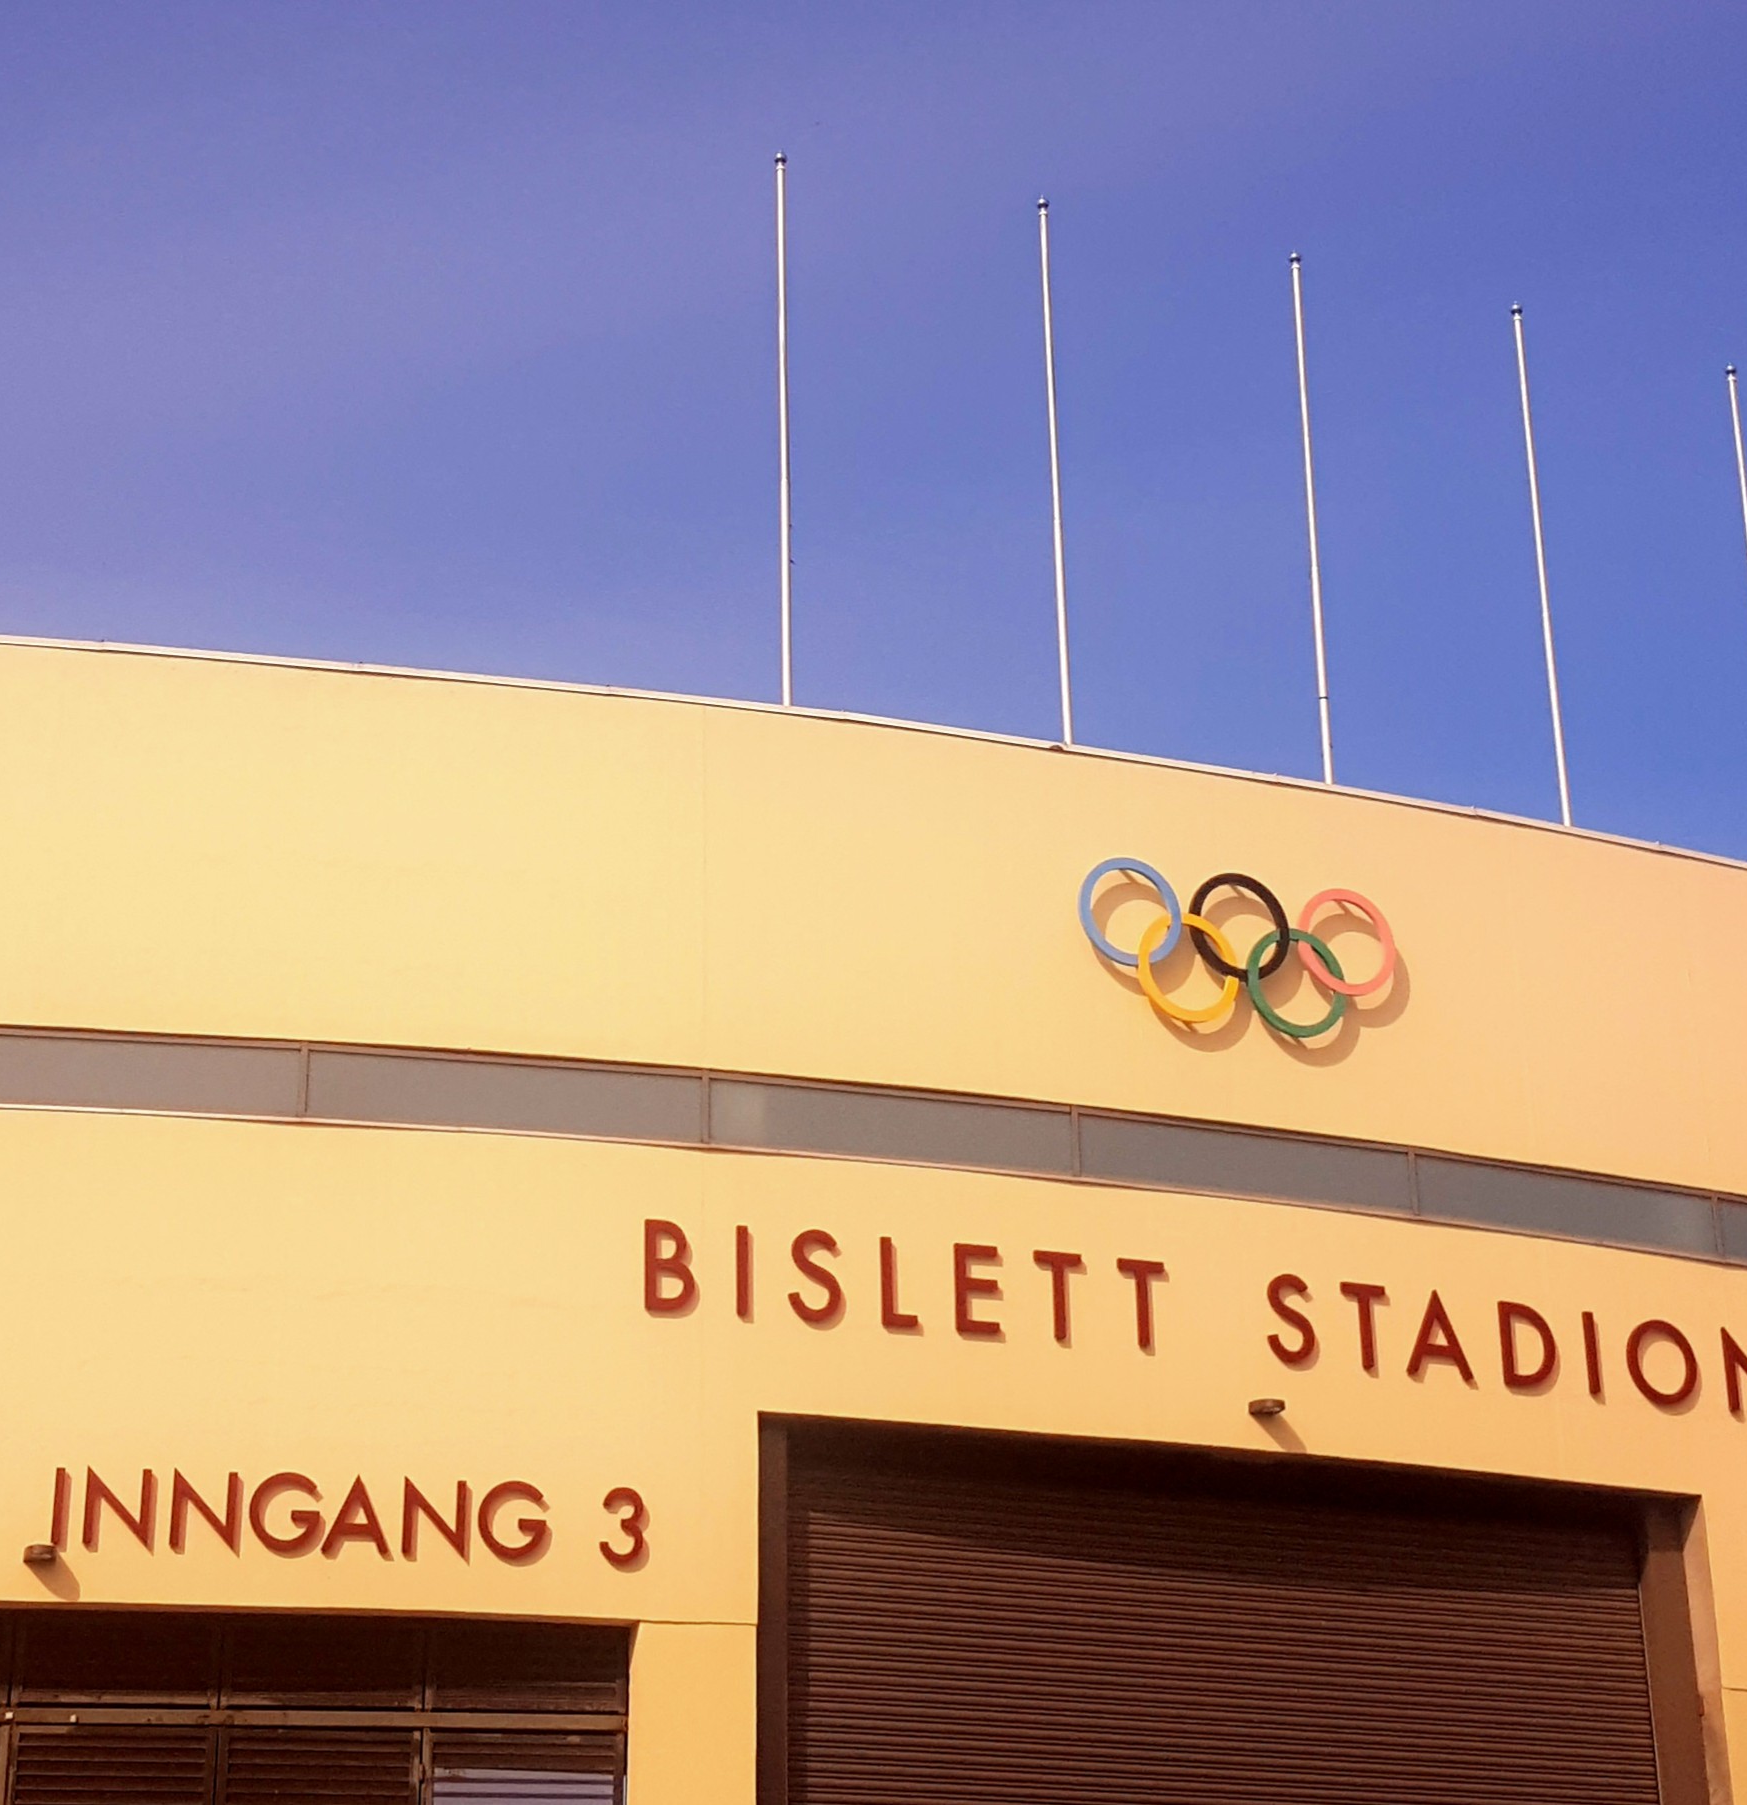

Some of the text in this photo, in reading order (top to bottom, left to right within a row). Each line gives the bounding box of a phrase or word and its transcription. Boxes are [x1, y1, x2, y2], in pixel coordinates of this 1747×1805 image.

[643, 1218, 1166, 1350] BISLETT
[50, 1465, 646, 1569] INNGANG 3
